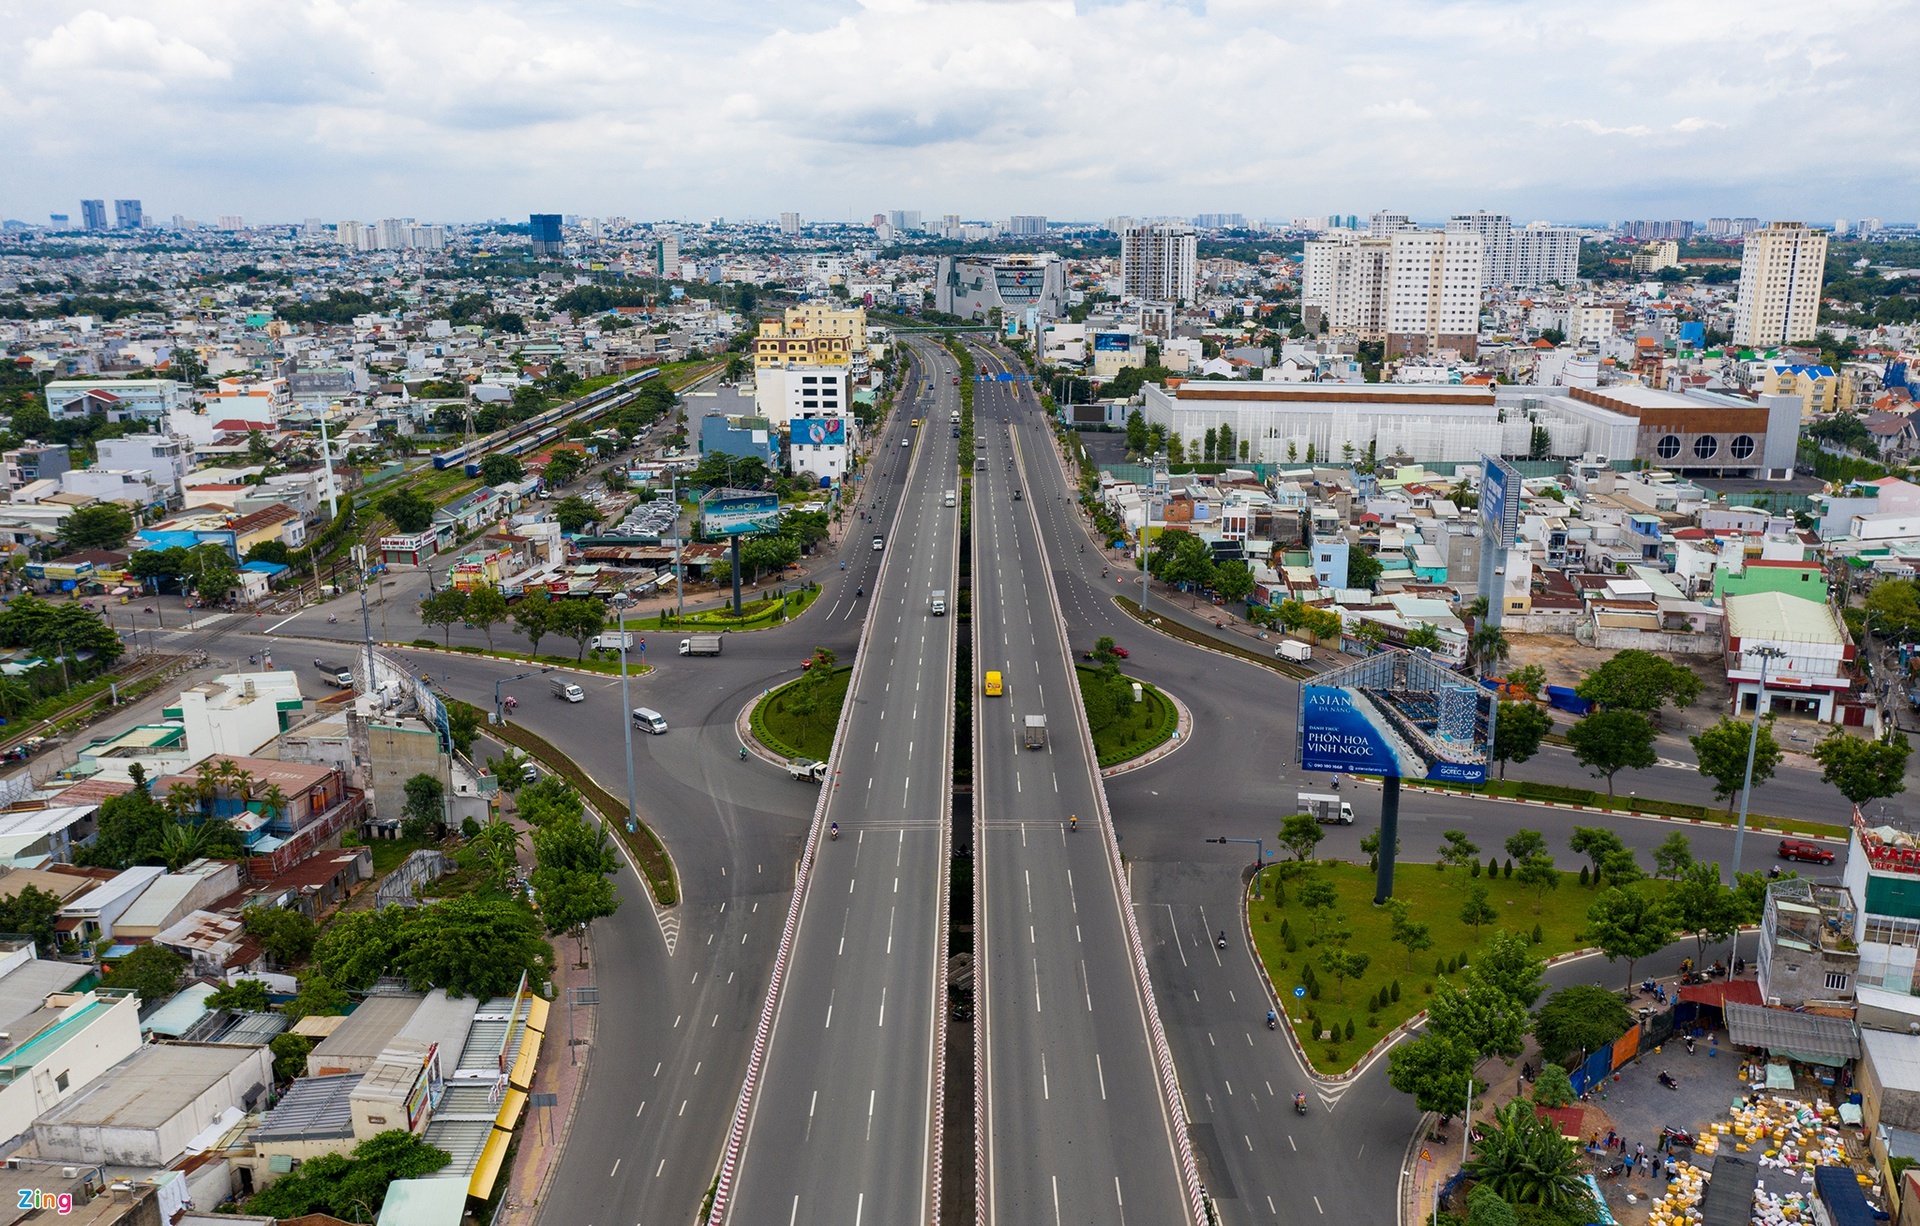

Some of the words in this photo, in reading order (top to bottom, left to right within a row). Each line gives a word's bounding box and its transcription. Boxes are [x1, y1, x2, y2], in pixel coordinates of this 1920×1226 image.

[1309, 695, 1360, 706] ASIANA
[1344, 736, 1369, 745] HOA
[1308, 743, 1336, 753] VỊNH
[1340, 745, 1374, 756] NGỌC
